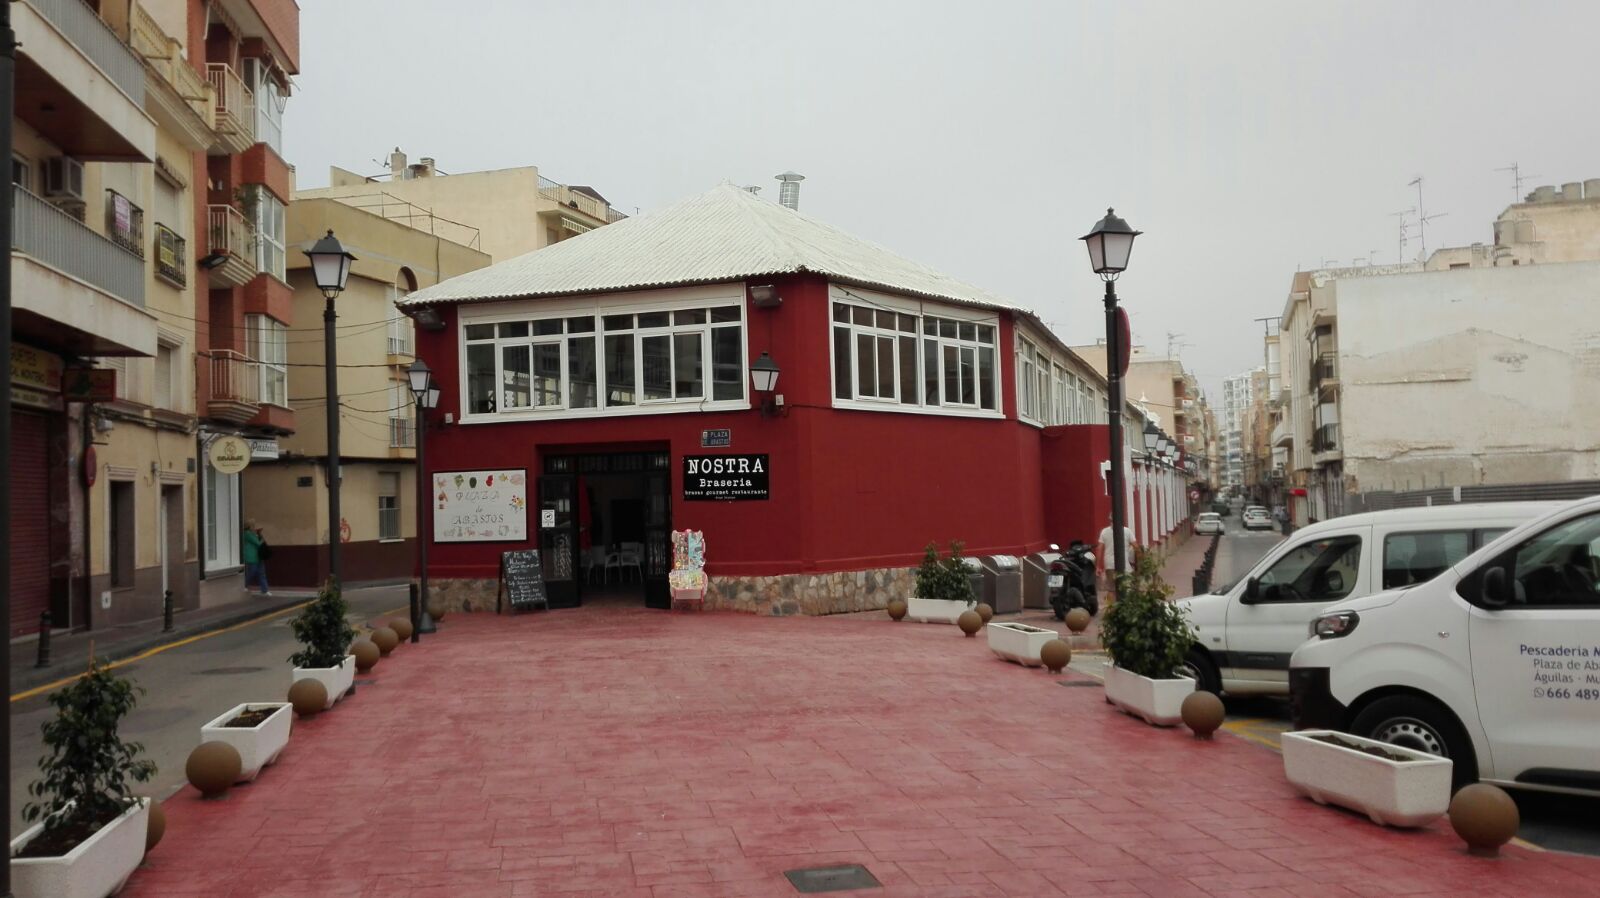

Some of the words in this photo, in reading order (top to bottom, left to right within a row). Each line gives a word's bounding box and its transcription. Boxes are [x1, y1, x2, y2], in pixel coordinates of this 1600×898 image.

[688, 458, 764, 474] NOSTRA
[453, 514, 504, 525] ABASTOS
[1533, 658, 1563, 670] Plaza
[1567, 660, 1581, 670] de
[1584, 661, 1600, 671] Ab
[1547, 688, 1571, 699] 666
[1575, 689, 1600, 700] 489
